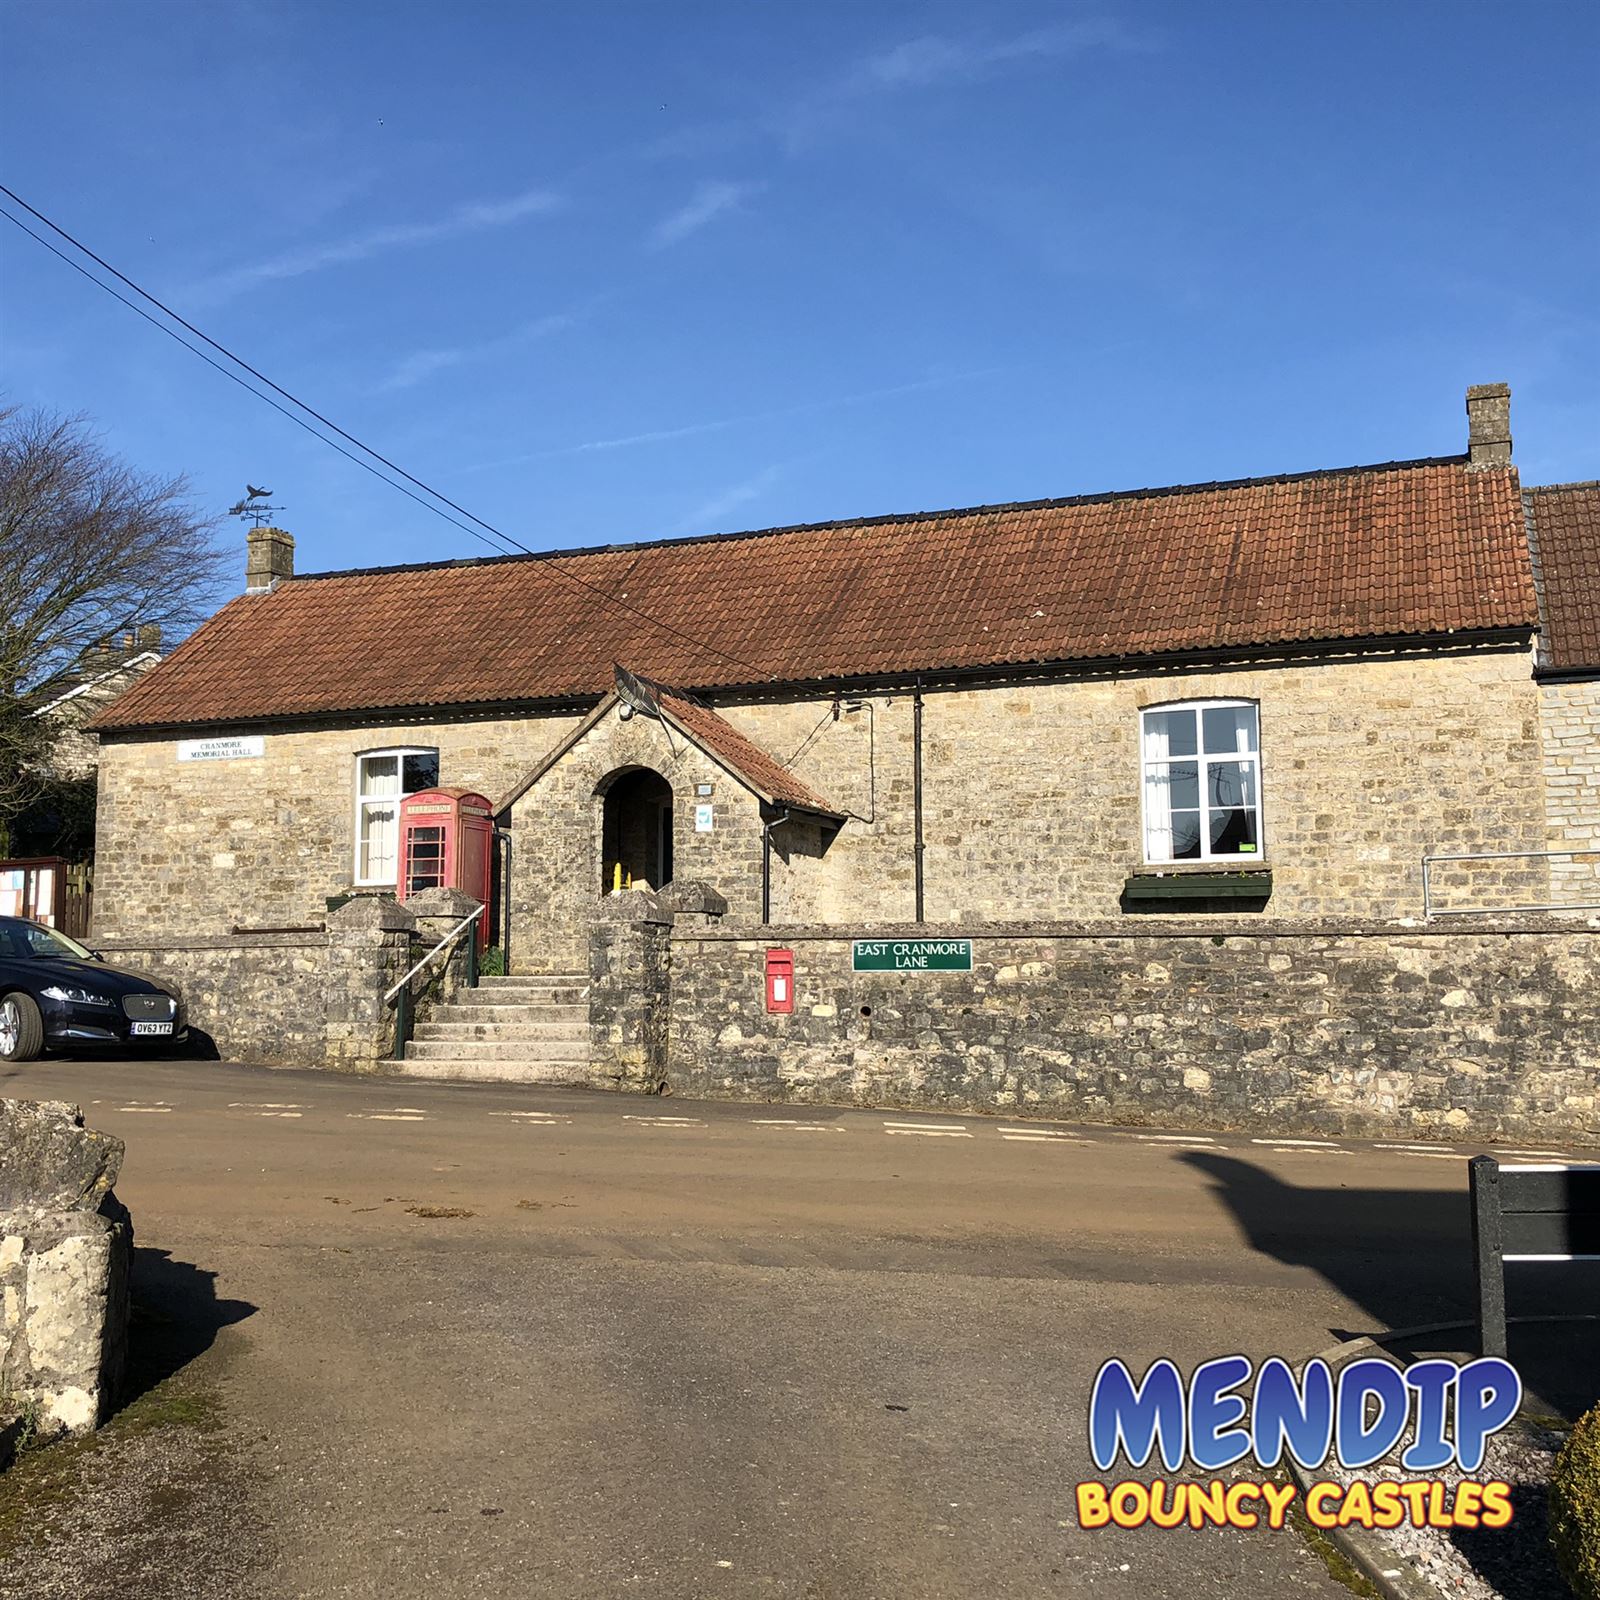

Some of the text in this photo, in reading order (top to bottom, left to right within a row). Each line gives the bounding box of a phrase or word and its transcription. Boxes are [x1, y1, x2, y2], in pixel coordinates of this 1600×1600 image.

[200, 741, 242, 750] CRANMORE
[190, 748, 253, 759] MEMORIAL HALL
[857, 943, 967, 956] EAST CRANMORE
[895, 956, 929, 968] LANE
